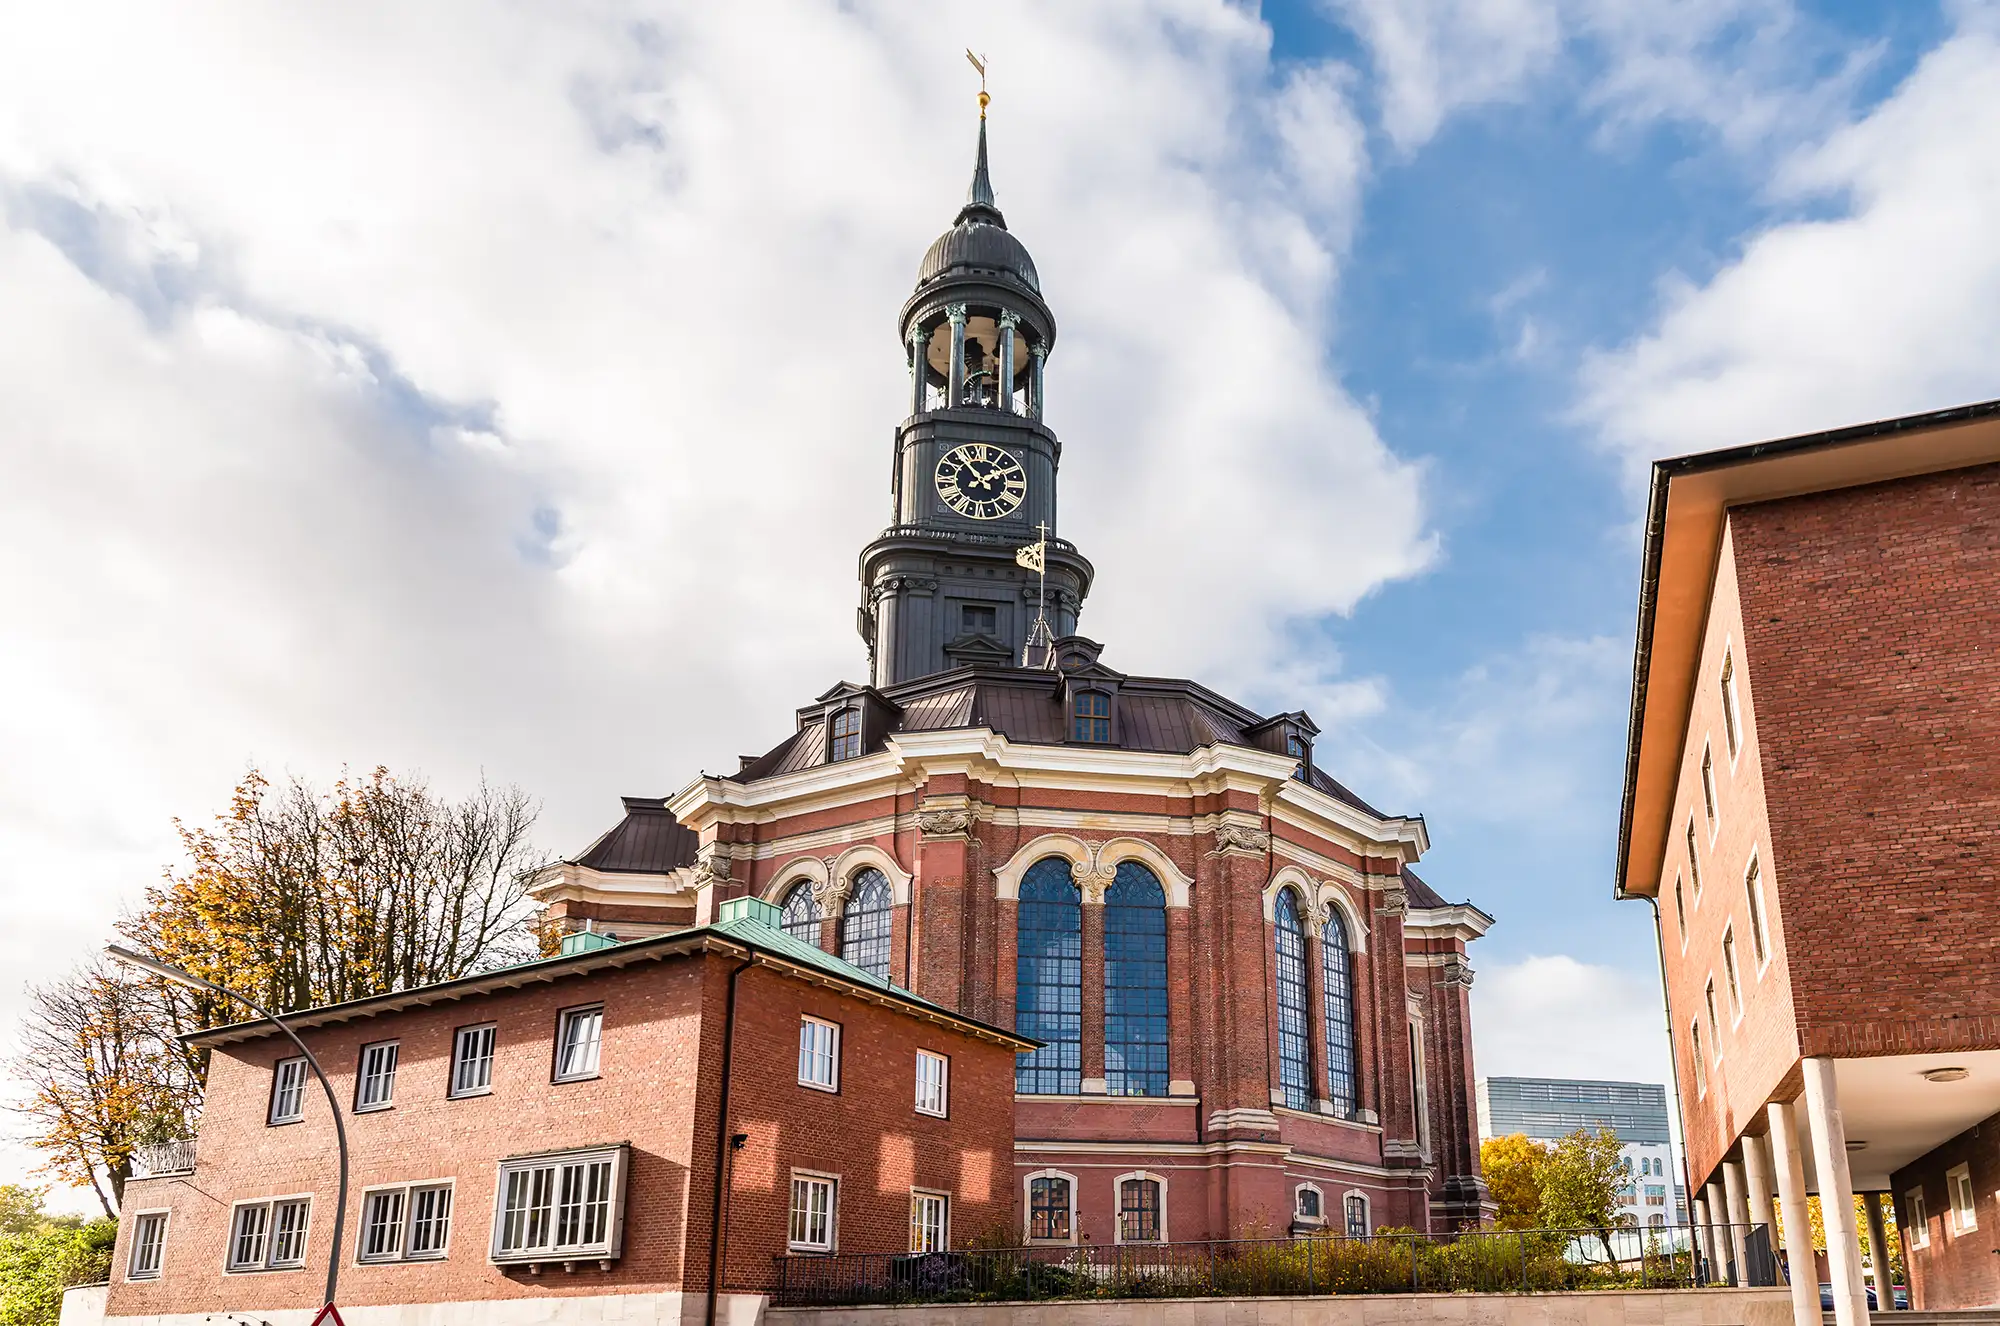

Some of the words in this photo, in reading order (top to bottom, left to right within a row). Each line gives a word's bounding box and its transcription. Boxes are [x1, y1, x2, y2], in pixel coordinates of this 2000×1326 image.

[974, 445, 987, 460] XII
[942, 457, 960, 470] X
[1007, 480, 1024, 489] III
[994, 501, 1006, 516] V
